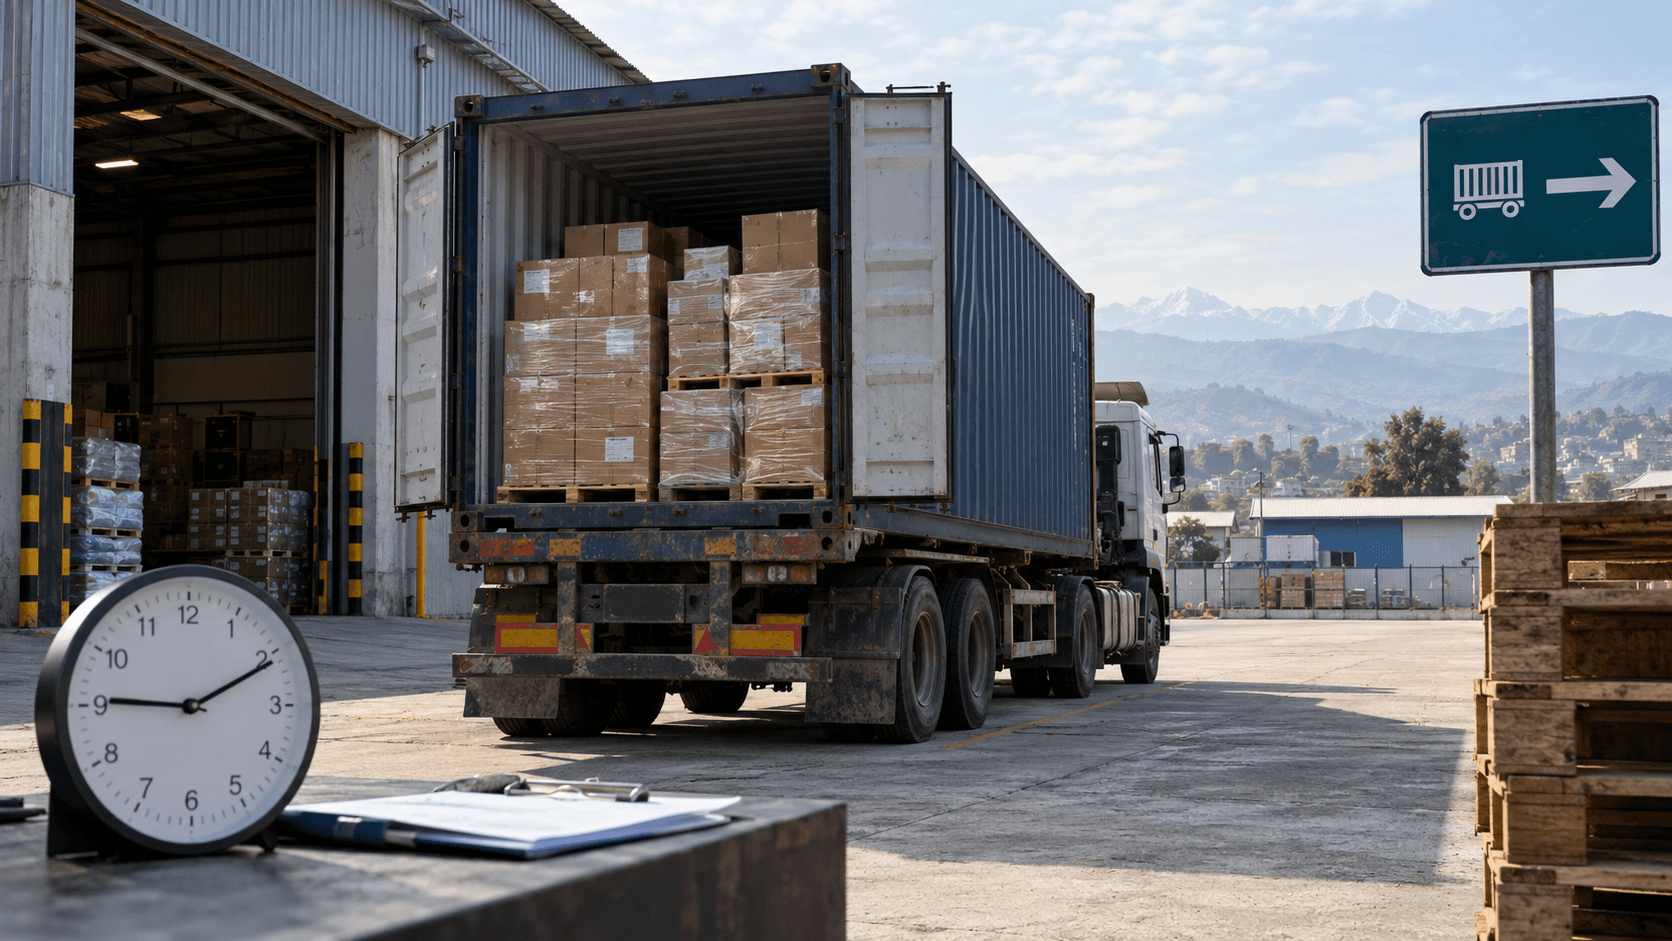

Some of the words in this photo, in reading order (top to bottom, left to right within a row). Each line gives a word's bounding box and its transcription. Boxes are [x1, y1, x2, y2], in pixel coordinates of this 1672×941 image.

[177, 604, 199, 625] 12
[137, 616, 156, 637] 11
[227, 618, 234, 639] 1
[105, 648, 129, 670] 10
[255, 650, 270, 670] 2
[93, 694, 108, 716] 9
[269, 694, 282, 715] 3
[104, 742, 119, 764] 8
[258, 740, 272, 760] 4
[139, 777, 154, 799] 7
[229, 774, 243, 796] 5
[184, 789, 199, 812] 6
